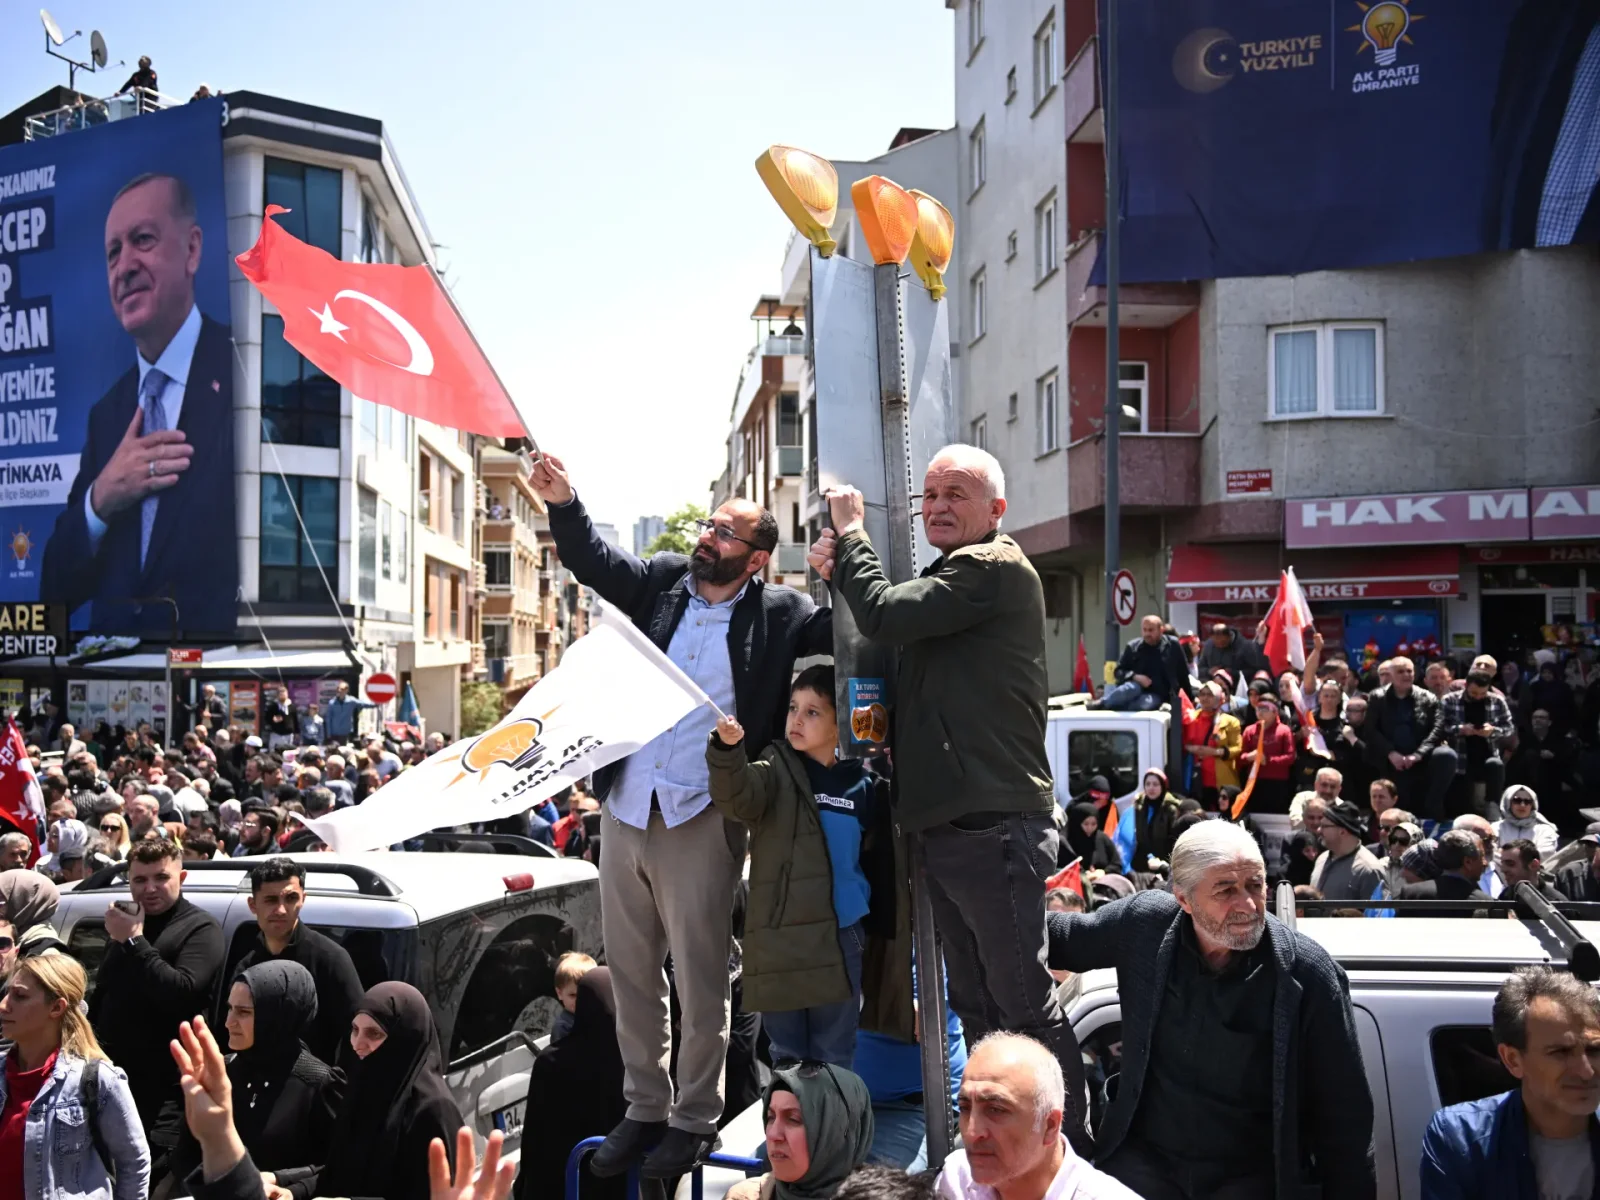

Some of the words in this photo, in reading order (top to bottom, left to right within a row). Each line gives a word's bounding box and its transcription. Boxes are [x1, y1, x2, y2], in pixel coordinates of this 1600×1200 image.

[1352, 71, 1374, 83] AK
[0, 207, 46, 255] CEP
[1302, 497, 1446, 528] HAK
[1224, 586, 1269, 600] HAK
[505, 1107, 521, 1131] 34
